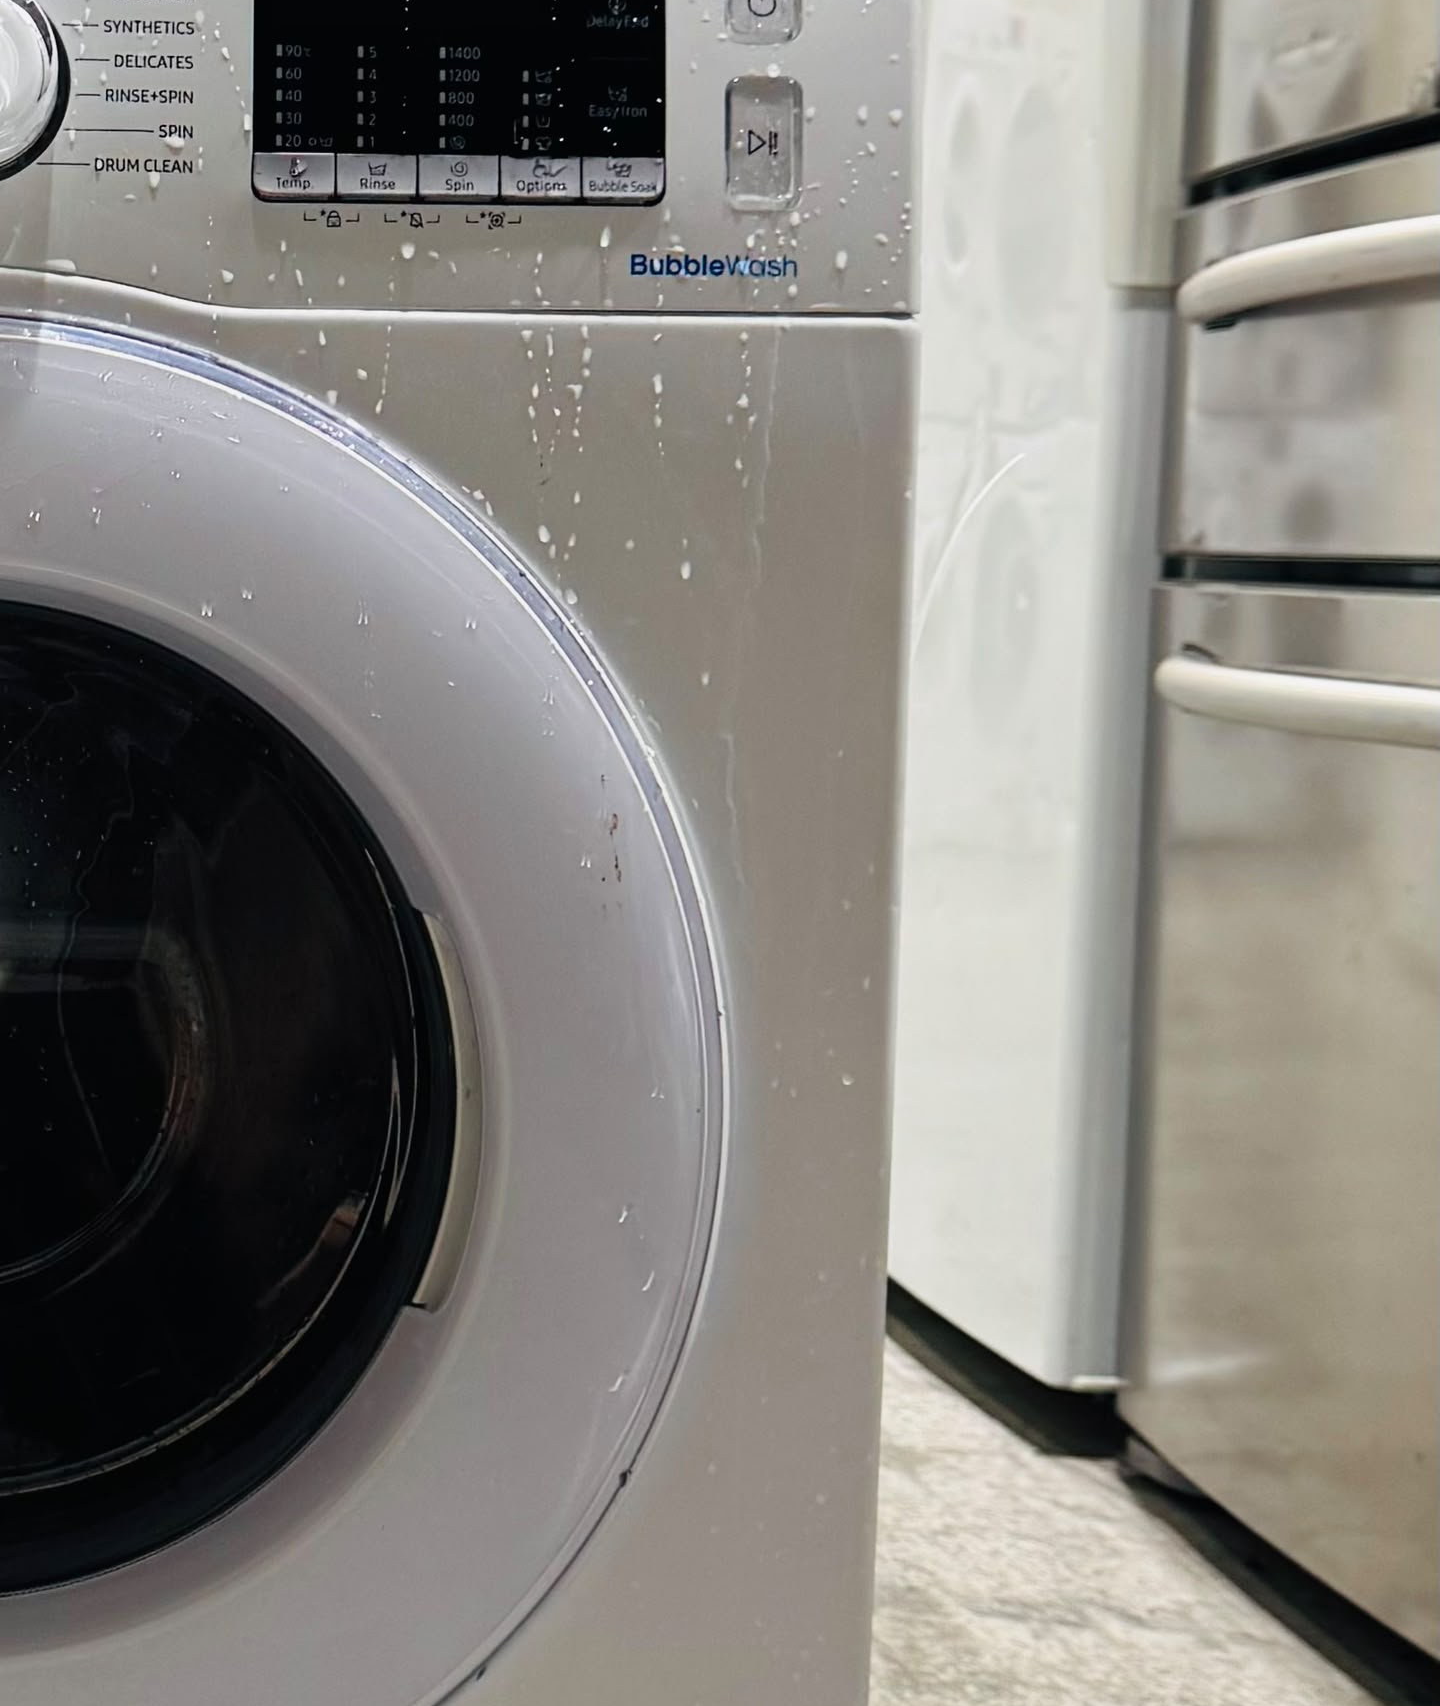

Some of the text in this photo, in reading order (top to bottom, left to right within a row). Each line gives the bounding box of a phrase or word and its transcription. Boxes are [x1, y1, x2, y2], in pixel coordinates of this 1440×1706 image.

[104, 20, 195, 35] SYNTHETICS
[369, 45, 377, 59] 5
[448, 46, 481, 60] 1400
[114, 54, 194, 69] DELICATES
[285, 67, 302, 80] 60
[369, 68, 377, 81] 4
[448, 69, 480, 82] 1200
[105, 89, 194, 104] RINSE+SPIN
[285, 89, 302, 102] 40
[369, 90, 377, 104] 3
[448, 91, 475, 105] 800
[285, 112, 302, 125] 30
[369, 113, 376, 126] 2
[448, 113, 474, 127] 400
[158, 125, 194, 139] SPIN
[285, 134, 302, 147] 20
[94, 157, 193, 173] DRUM CLEAN
[360, 177, 396, 191] Rinse
[446, 178, 475, 193] Spin
[589, 179, 629, 192] Bubble
